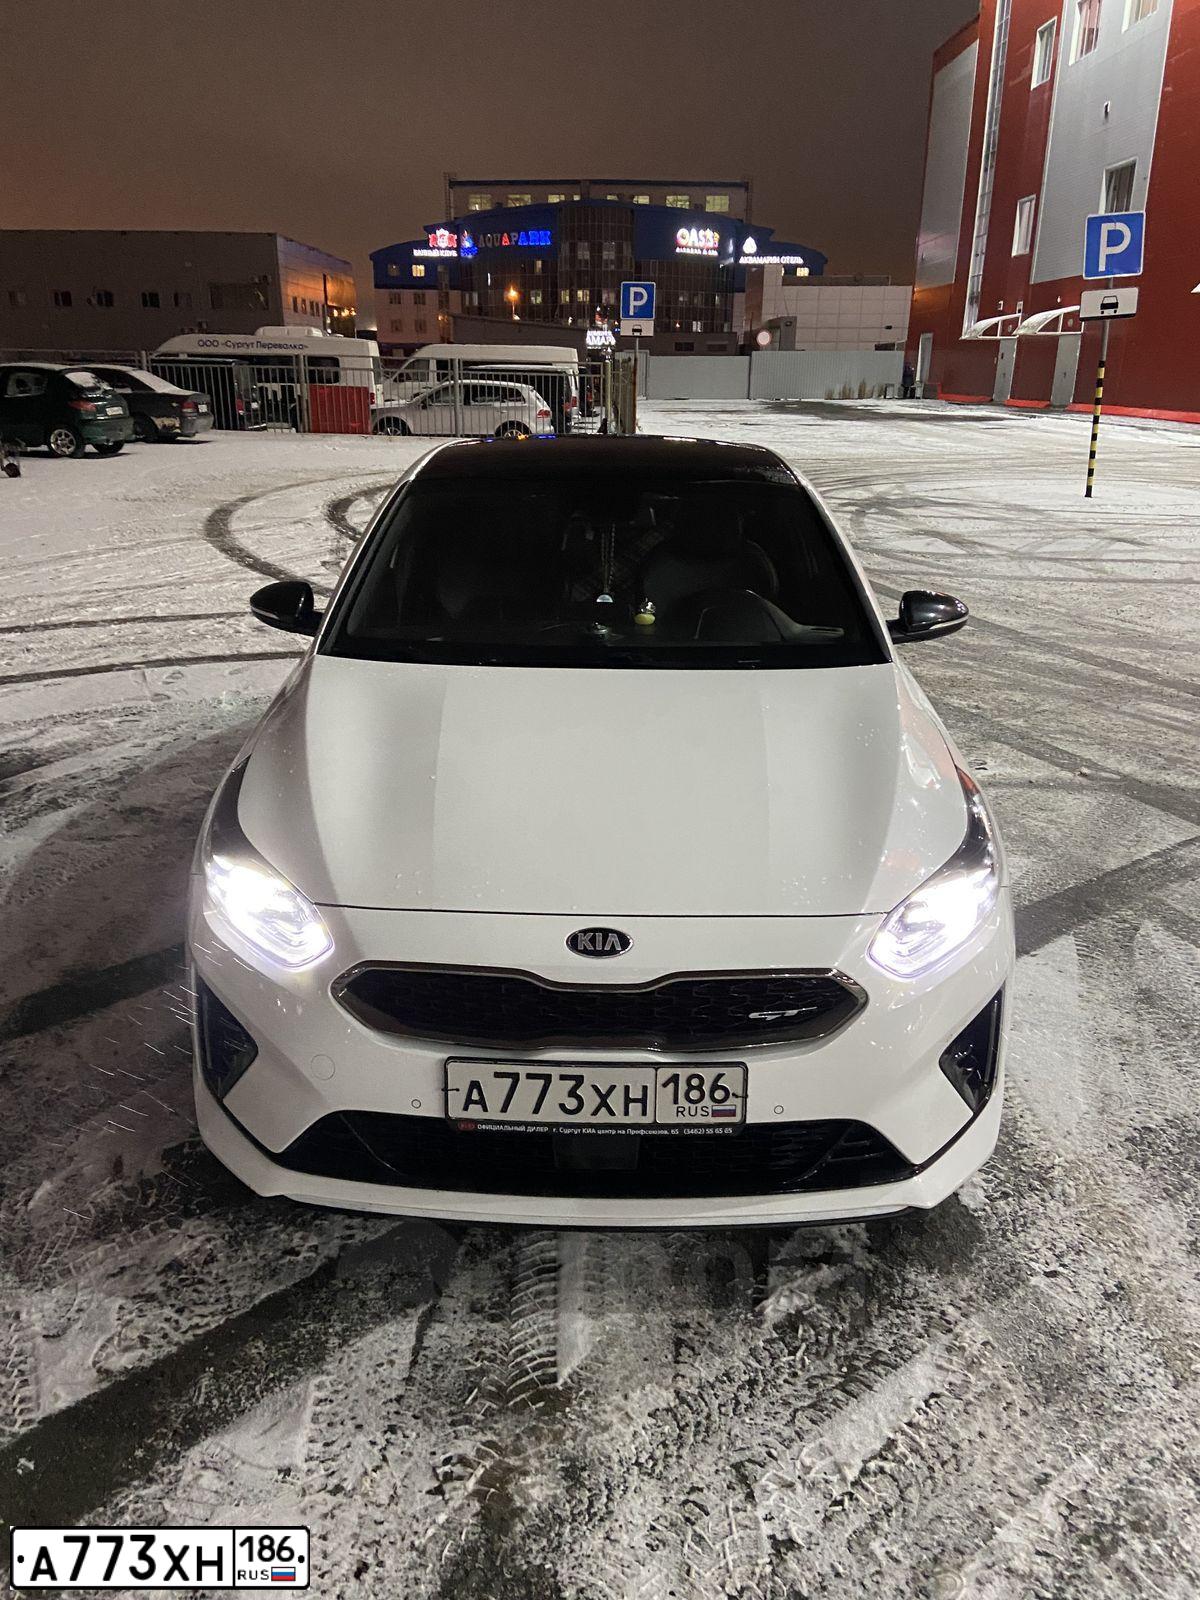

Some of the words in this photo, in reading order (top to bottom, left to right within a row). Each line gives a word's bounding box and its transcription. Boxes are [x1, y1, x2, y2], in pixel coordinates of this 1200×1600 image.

[479, 230, 551, 248] AQUAPARK
[1098, 223, 1131, 272] P
[629, 286, 648, 316] P
[197, 339, 219, 348] ООО
[577, 932, 622, 951] KIA
[661, 1072, 731, 1105] 186
[676, 1105, 710, 1118] RUS
[477, 1123, 525, 1132] ОФИЦИАЛЬНЫЙ
[526, 1125, 549, 1133] ДИЛЕР
[559, 1126, 581, 1135] Сургут
[597, 1128, 616, 1136] центр
